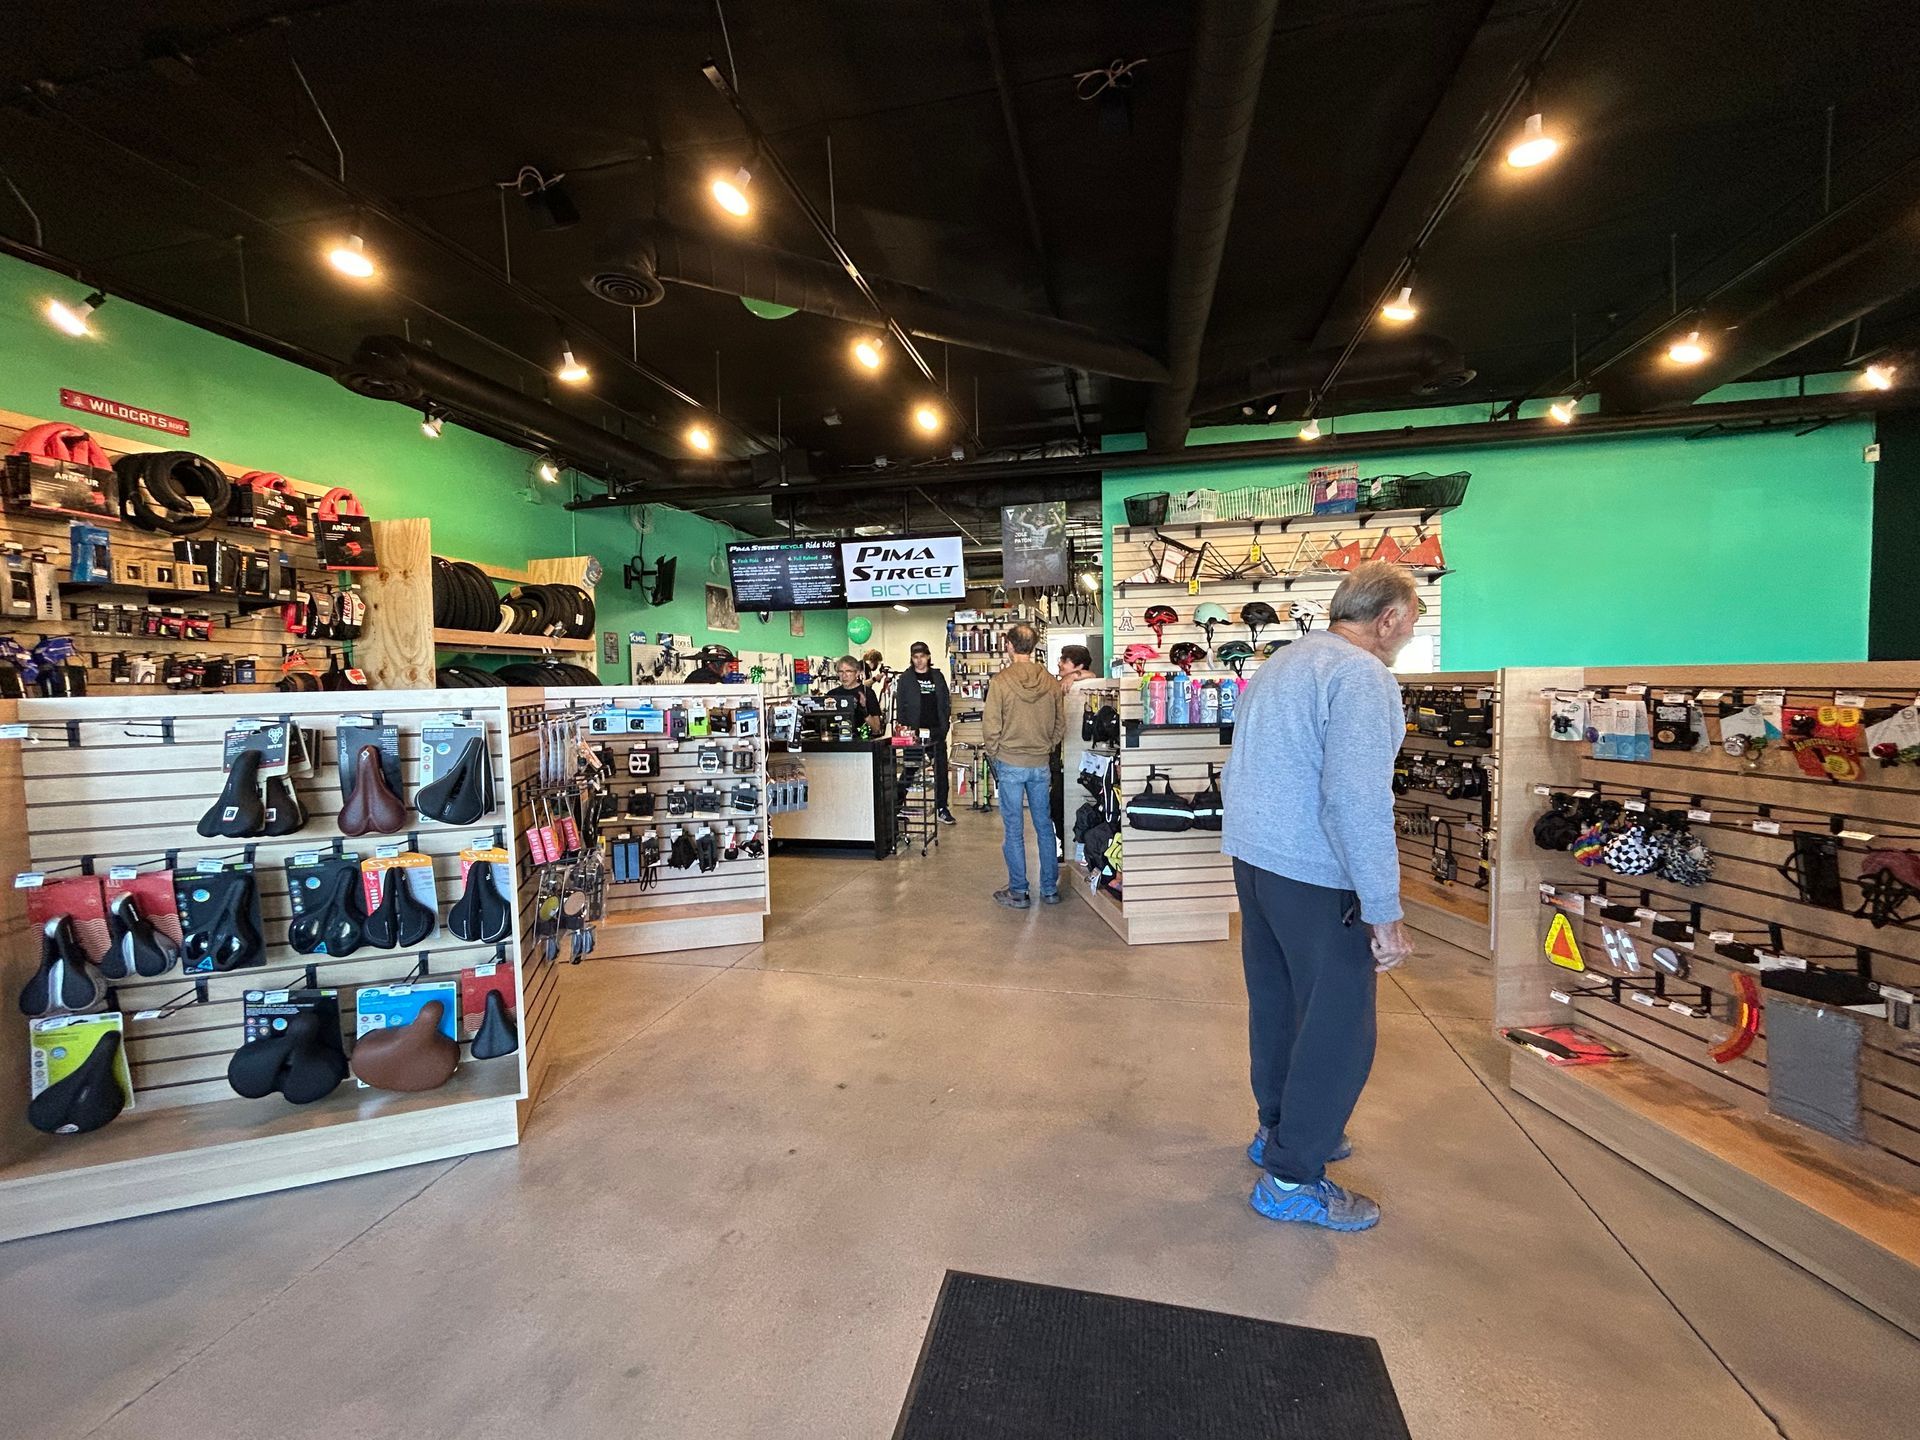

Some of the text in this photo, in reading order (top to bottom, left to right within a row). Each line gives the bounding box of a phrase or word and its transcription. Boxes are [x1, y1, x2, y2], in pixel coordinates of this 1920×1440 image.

[88, 398, 168, 428] WILDCATS
[805, 541, 821, 549] Ride
[822, 541, 836, 549] Kits
[856, 546, 935, 563] PIMA
[849, 565, 959, 582] STREET
[871, 582, 952, 597] BICYCLE
